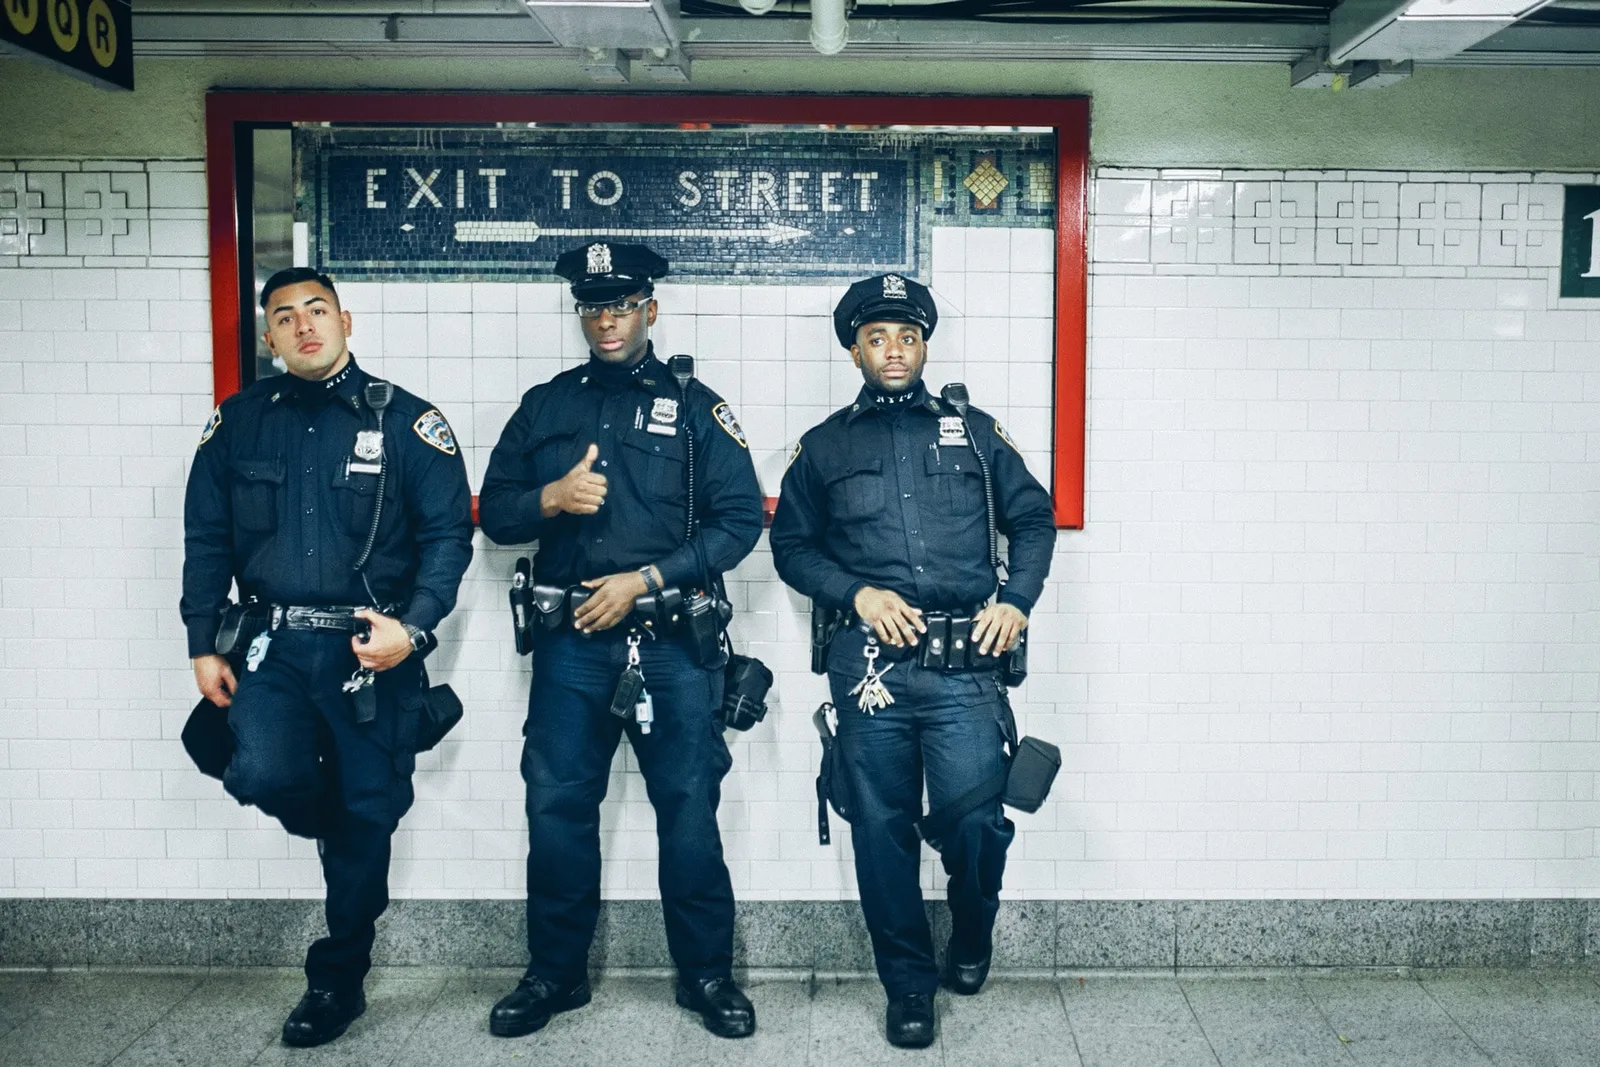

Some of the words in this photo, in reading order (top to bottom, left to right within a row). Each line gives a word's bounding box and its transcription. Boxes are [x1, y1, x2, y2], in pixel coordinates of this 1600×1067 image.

[54, 0, 72, 37] Q
[95, 13, 110, 53] R
[366, 168, 507, 209] EXIT
[552, 169, 624, 210] TO
[678, 170, 879, 212] STREET
